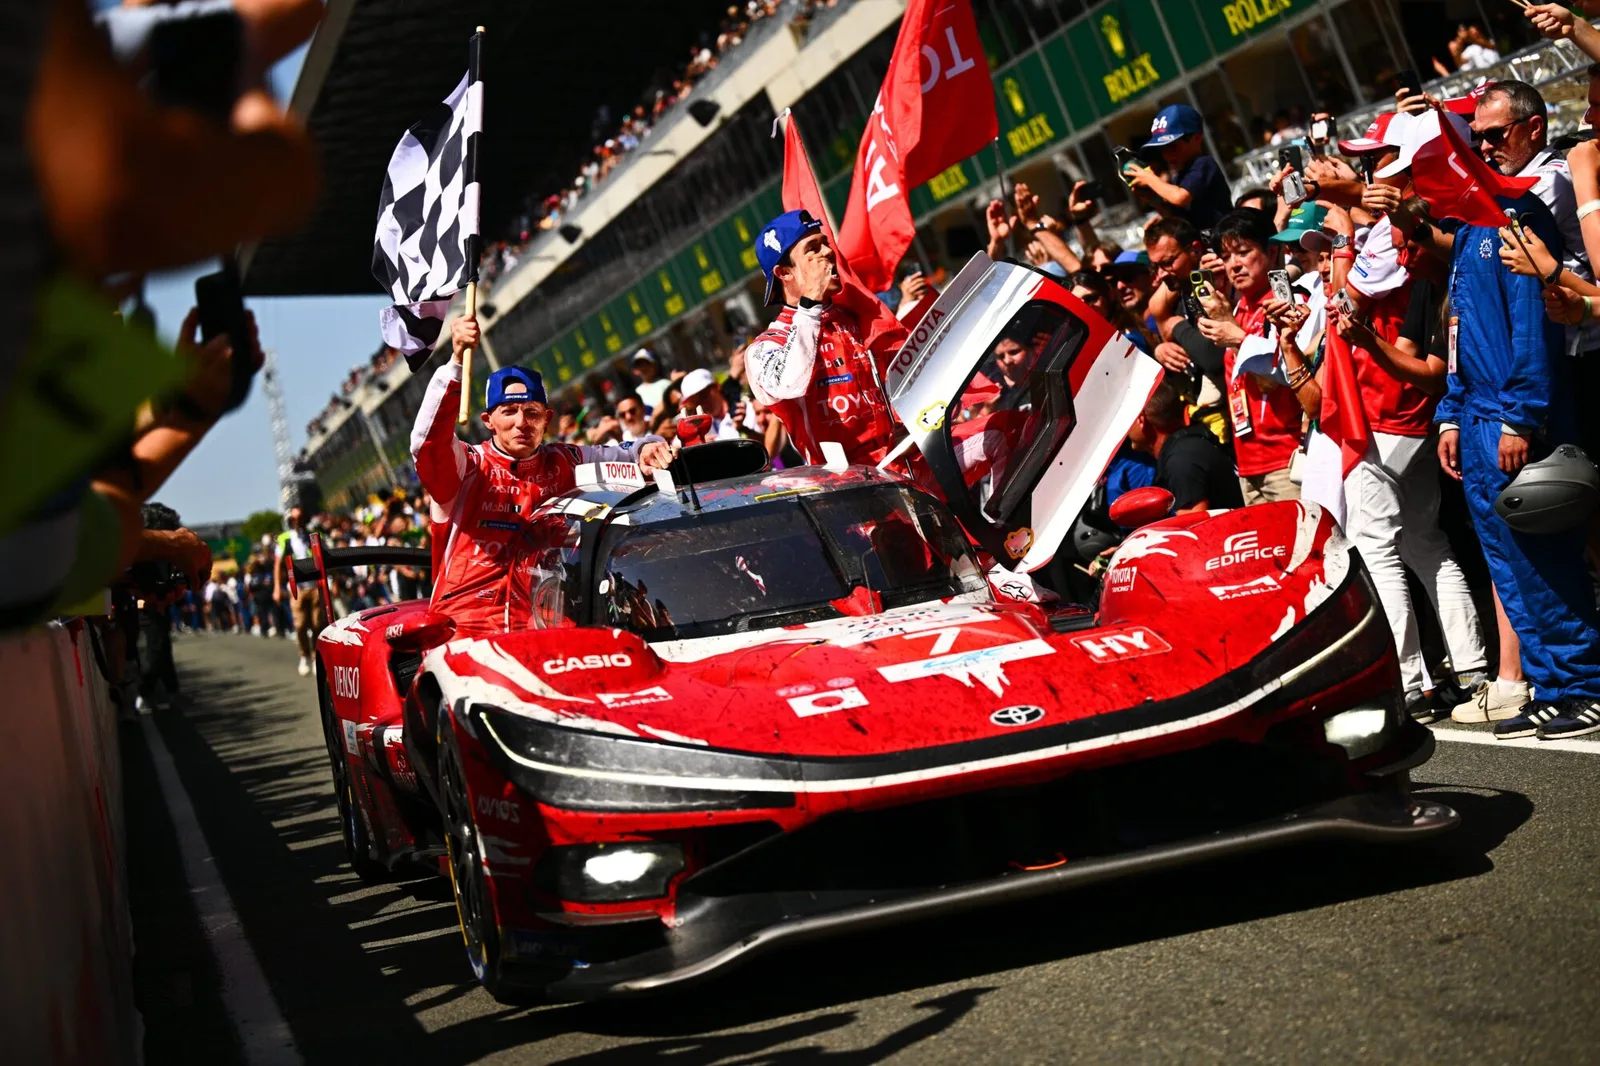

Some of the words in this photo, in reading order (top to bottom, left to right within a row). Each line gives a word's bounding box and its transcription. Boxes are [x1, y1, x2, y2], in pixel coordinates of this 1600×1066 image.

[1103, 53, 1159, 103] ROLEX
[890, 308, 945, 376] TOYOTA
[605, 463, 637, 480] TOYOTA
[482, 502, 510, 513] Mobil
[1205, 545, 1287, 571] EDIFICE
[1111, 567, 1131, 584] TOYOTA
[1130, 566, 1137, 591] 7
[1218, 585, 1282, 601] MARELLI
[902, 626, 961, 656] 7
[1080, 631, 1150, 658] HY
[542, 653, 632, 675] CASIO
[333, 665, 360, 700] DENSO
[606, 695, 673, 709] MARELLI
